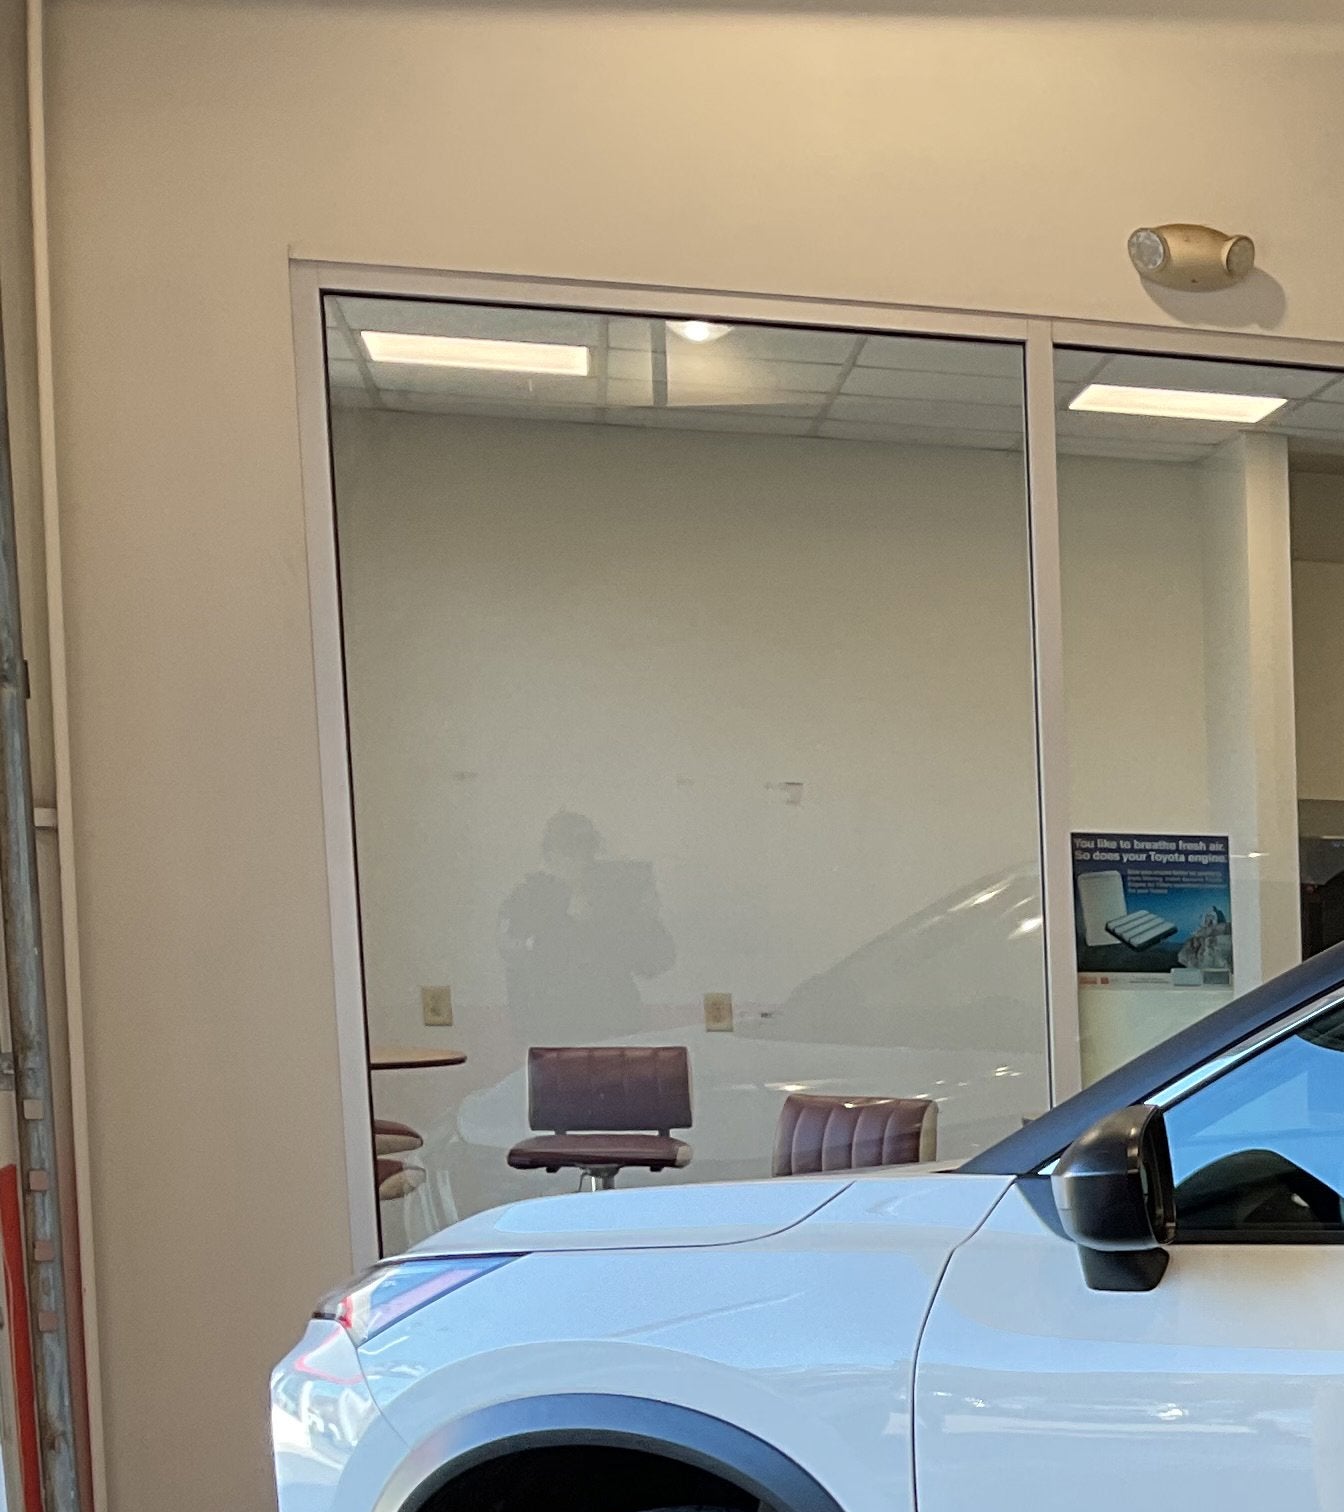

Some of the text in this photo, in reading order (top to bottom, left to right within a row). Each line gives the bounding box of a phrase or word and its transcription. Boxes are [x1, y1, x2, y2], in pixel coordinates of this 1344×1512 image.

[1074, 837, 1094, 849] You
[1097, 838, 1117, 850] like
[1119, 840, 1131, 850] to
[1133, 839, 1176, 852] breathe
[1178, 840, 1207, 852] fresh
[1074, 850, 1090, 861] So
[1092, 850, 1120, 862] does
[1122, 852, 1147, 864] your
[1149, 851, 1185, 864] Toyota
